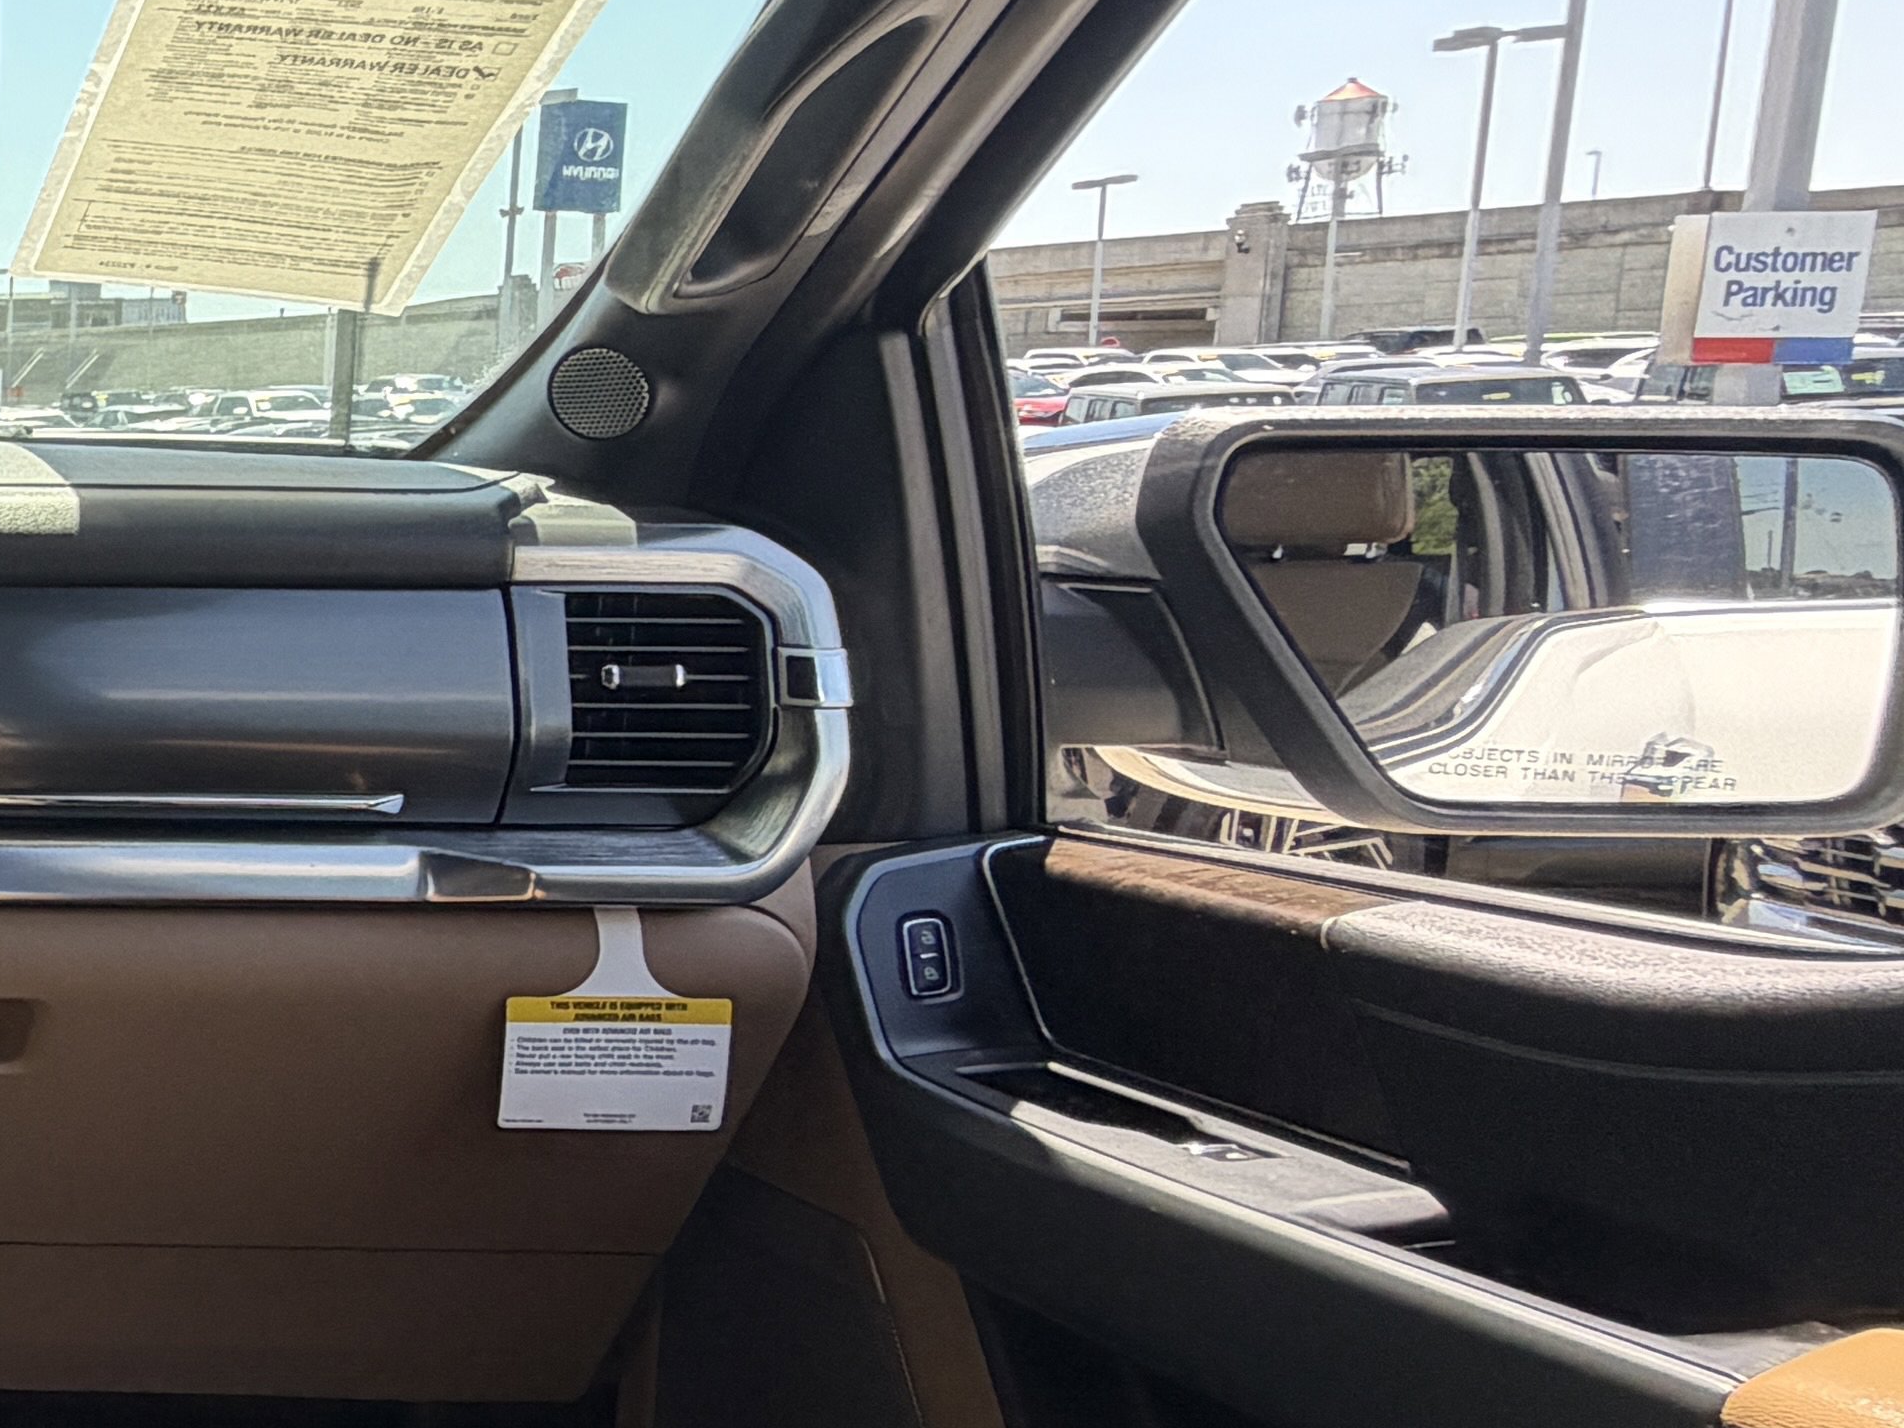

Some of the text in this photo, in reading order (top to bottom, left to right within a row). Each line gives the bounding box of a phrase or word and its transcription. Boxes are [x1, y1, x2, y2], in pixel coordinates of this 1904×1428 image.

[1713, 244, 1861, 274] Customer
[1723, 279, 1838, 314] Parking
[1552, 752, 1574, 766] IN
[1428, 762, 1508, 779] CLOSER
[1520, 767, 1576, 782] THAN
